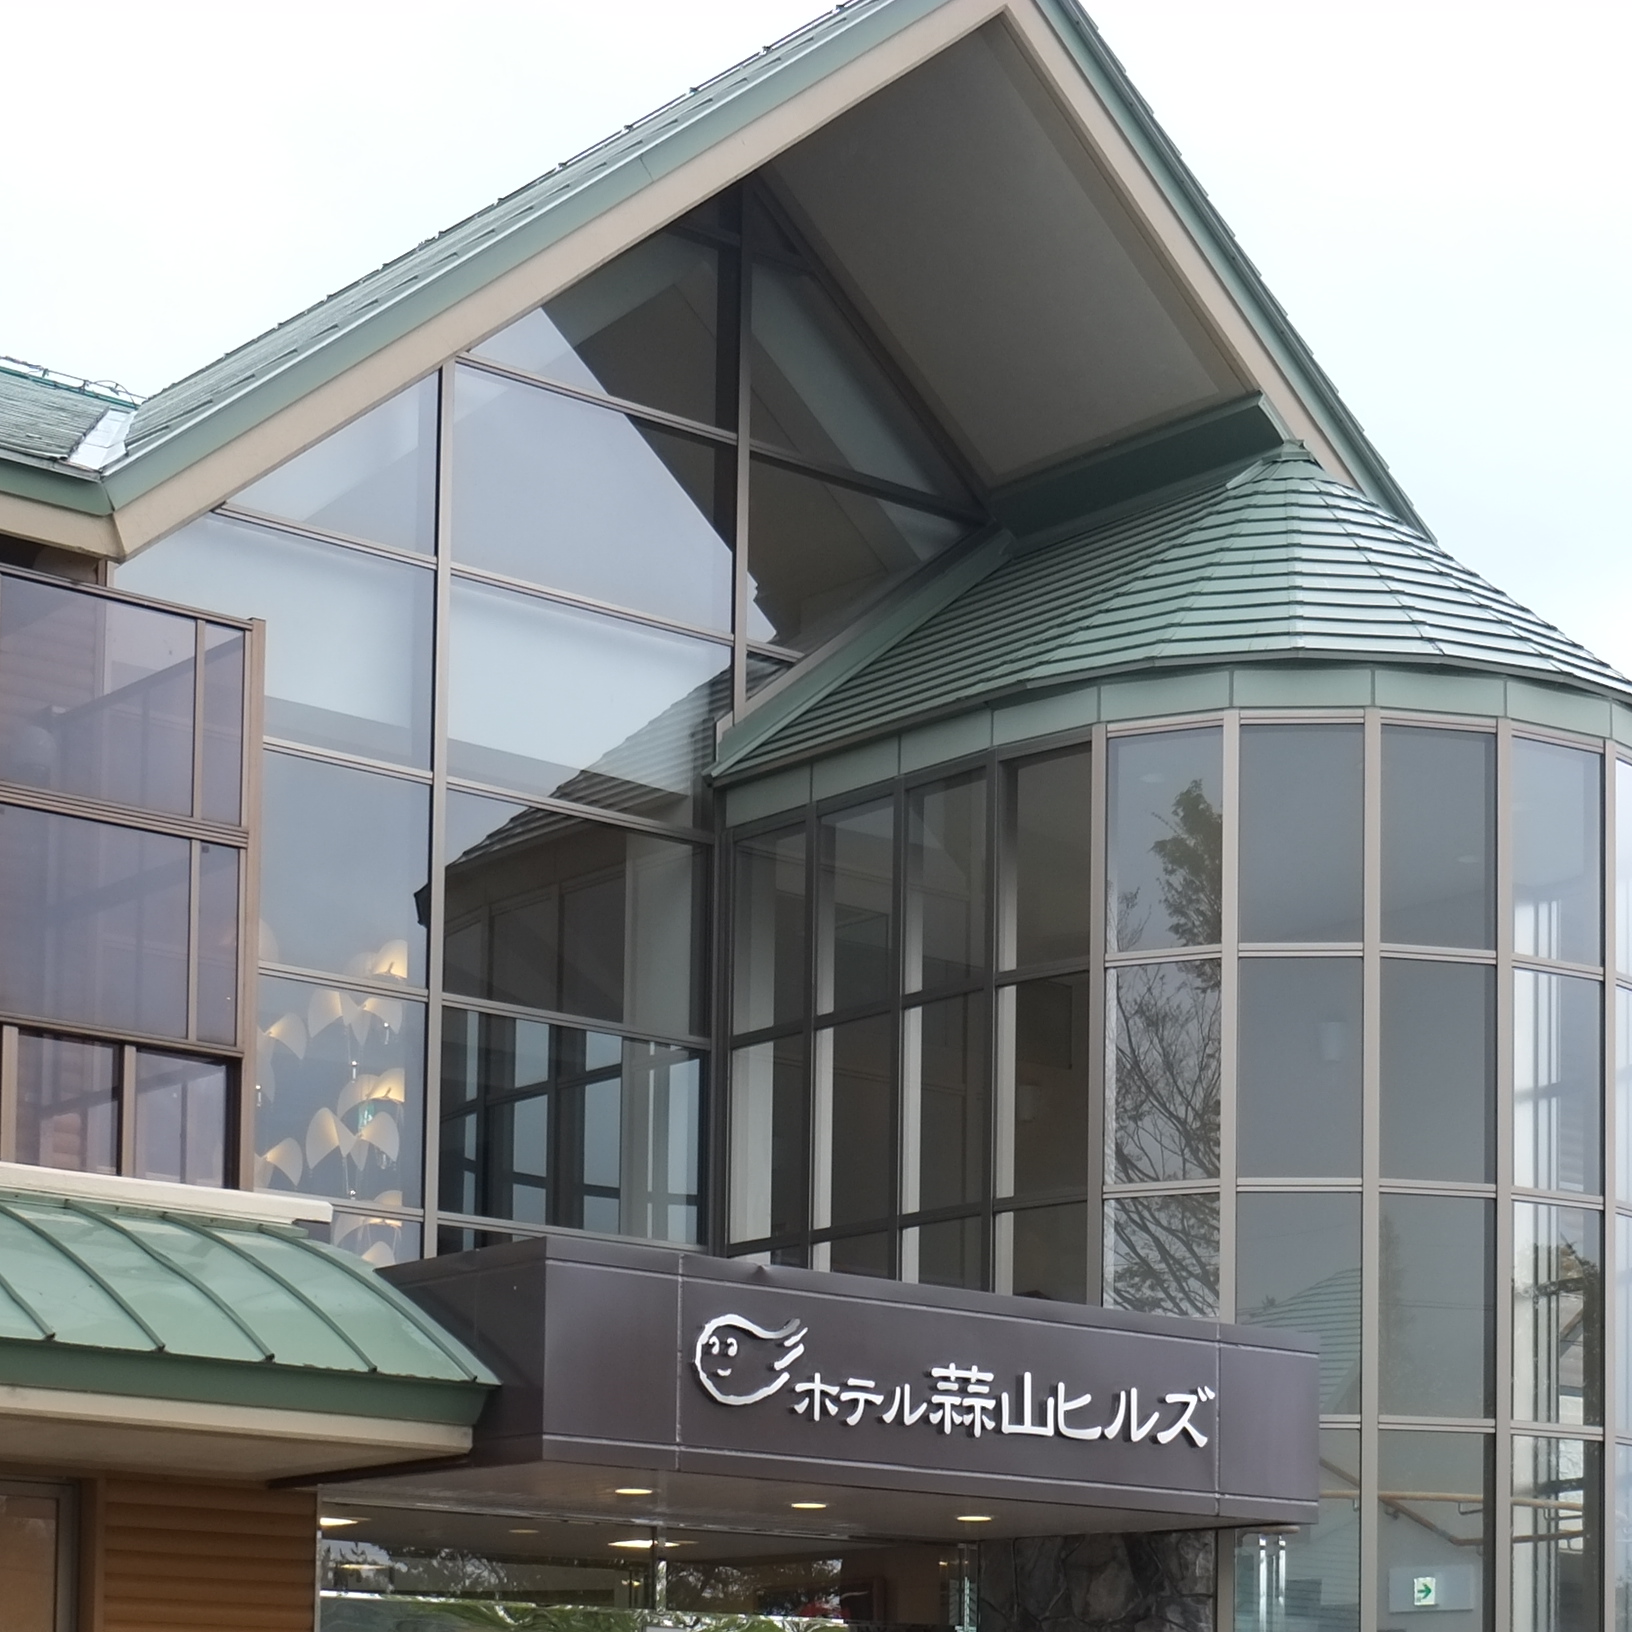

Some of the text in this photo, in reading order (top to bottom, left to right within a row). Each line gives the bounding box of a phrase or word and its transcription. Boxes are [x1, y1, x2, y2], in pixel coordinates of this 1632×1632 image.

[793, 1363, 1216, 1448] ホテル蒜山ヒルズ
